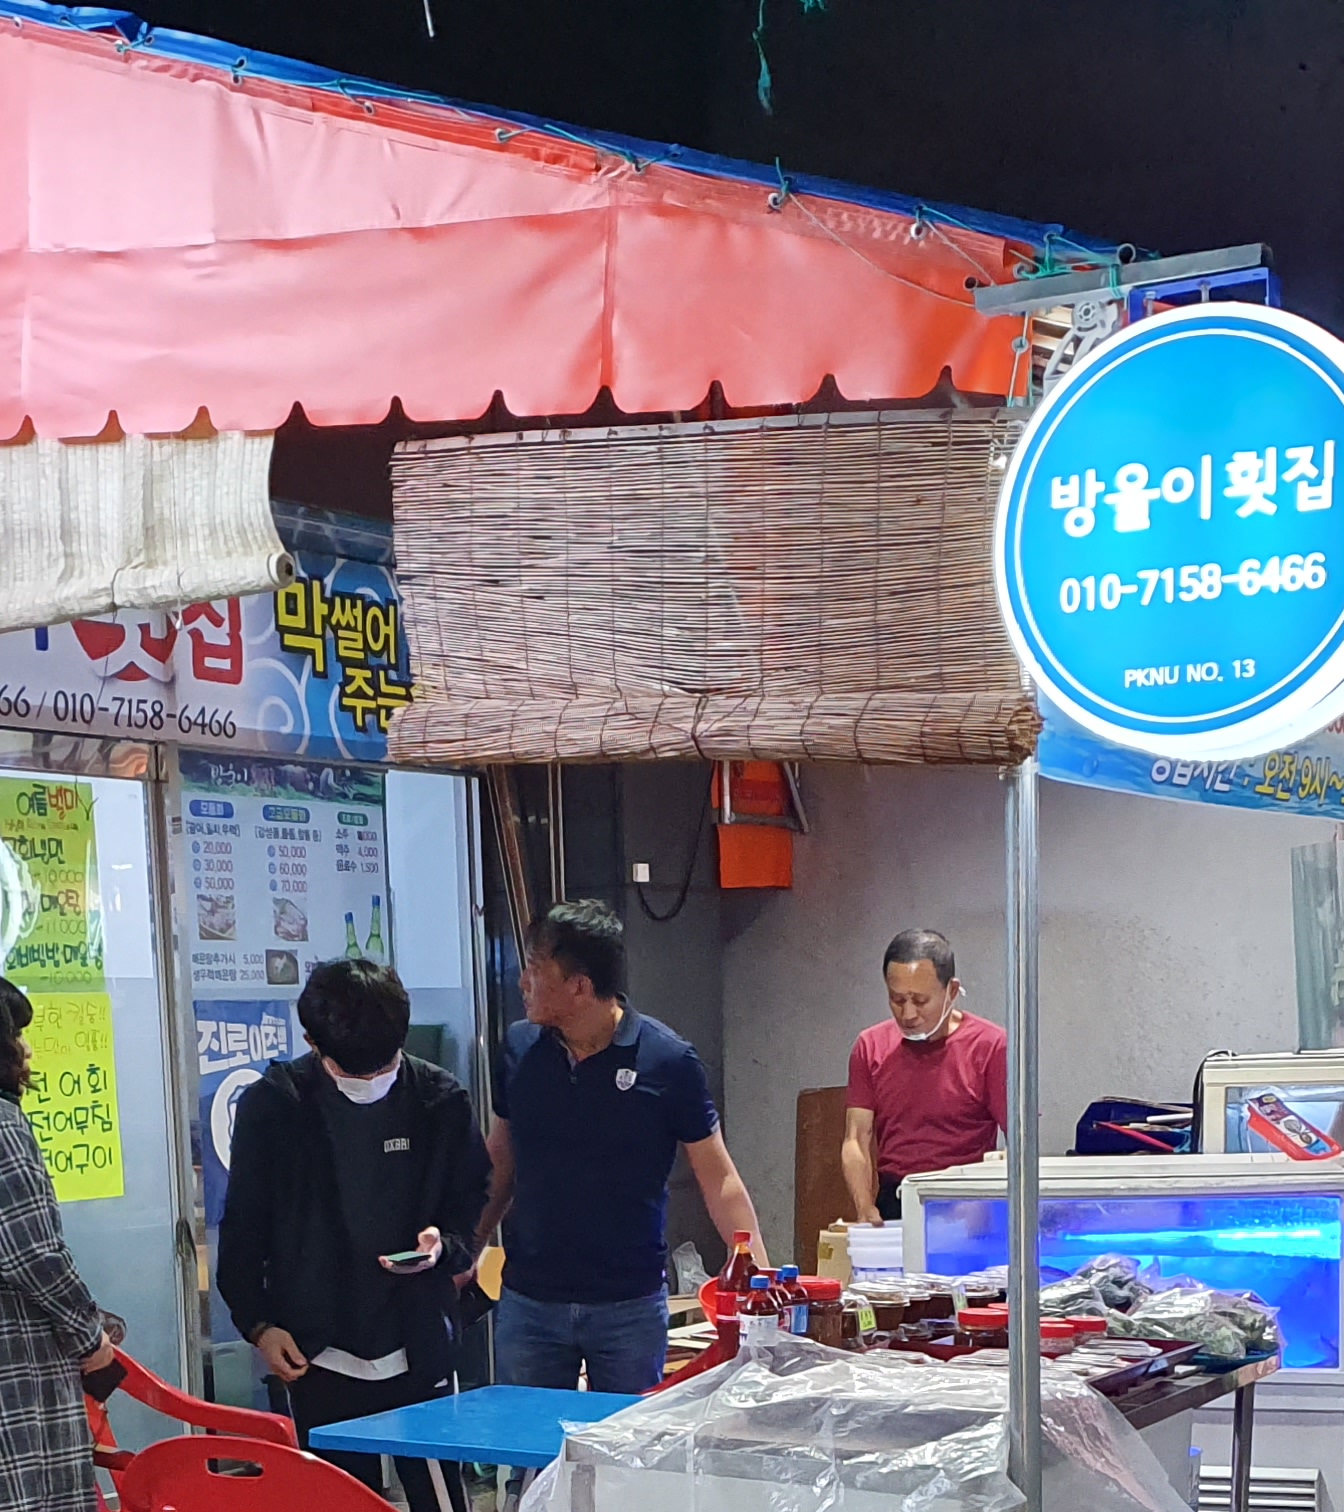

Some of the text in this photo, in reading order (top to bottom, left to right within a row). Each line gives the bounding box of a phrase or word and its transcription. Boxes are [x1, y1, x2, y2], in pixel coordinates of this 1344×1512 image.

[1059, 552, 1327, 614] 010-7158-6466
[274, 580, 399, 675] 막썰어
[1124, 658, 1256, 688] PKNU NO. 13
[52, 690, 237, 740] 010-7158-6466
[1254, 752, 1299, 801] 오전
